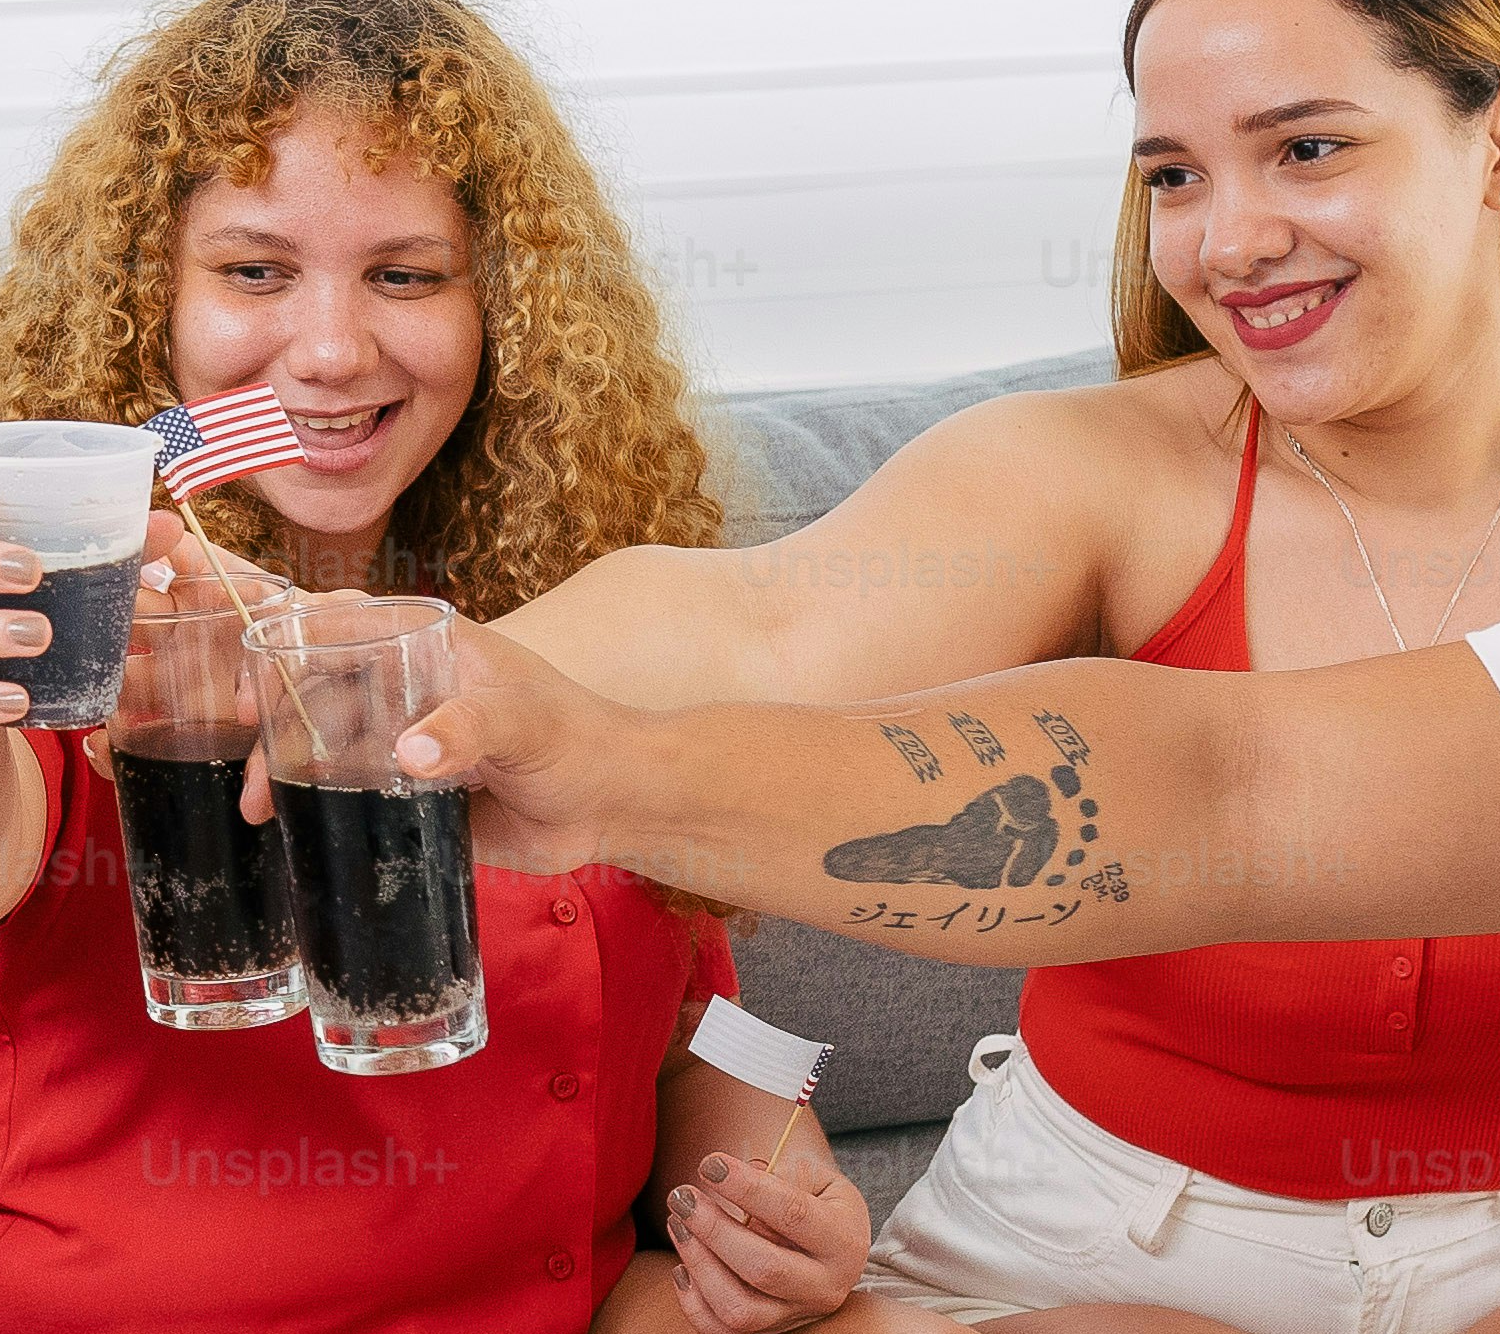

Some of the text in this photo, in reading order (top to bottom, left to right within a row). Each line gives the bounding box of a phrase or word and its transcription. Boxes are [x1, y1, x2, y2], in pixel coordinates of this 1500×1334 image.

[966, 728, 992, 745] 18
[1050, 724, 1079, 746] 07
[897, 738, 928, 762] 22
[1103, 862, 1130, 902] 12:39
